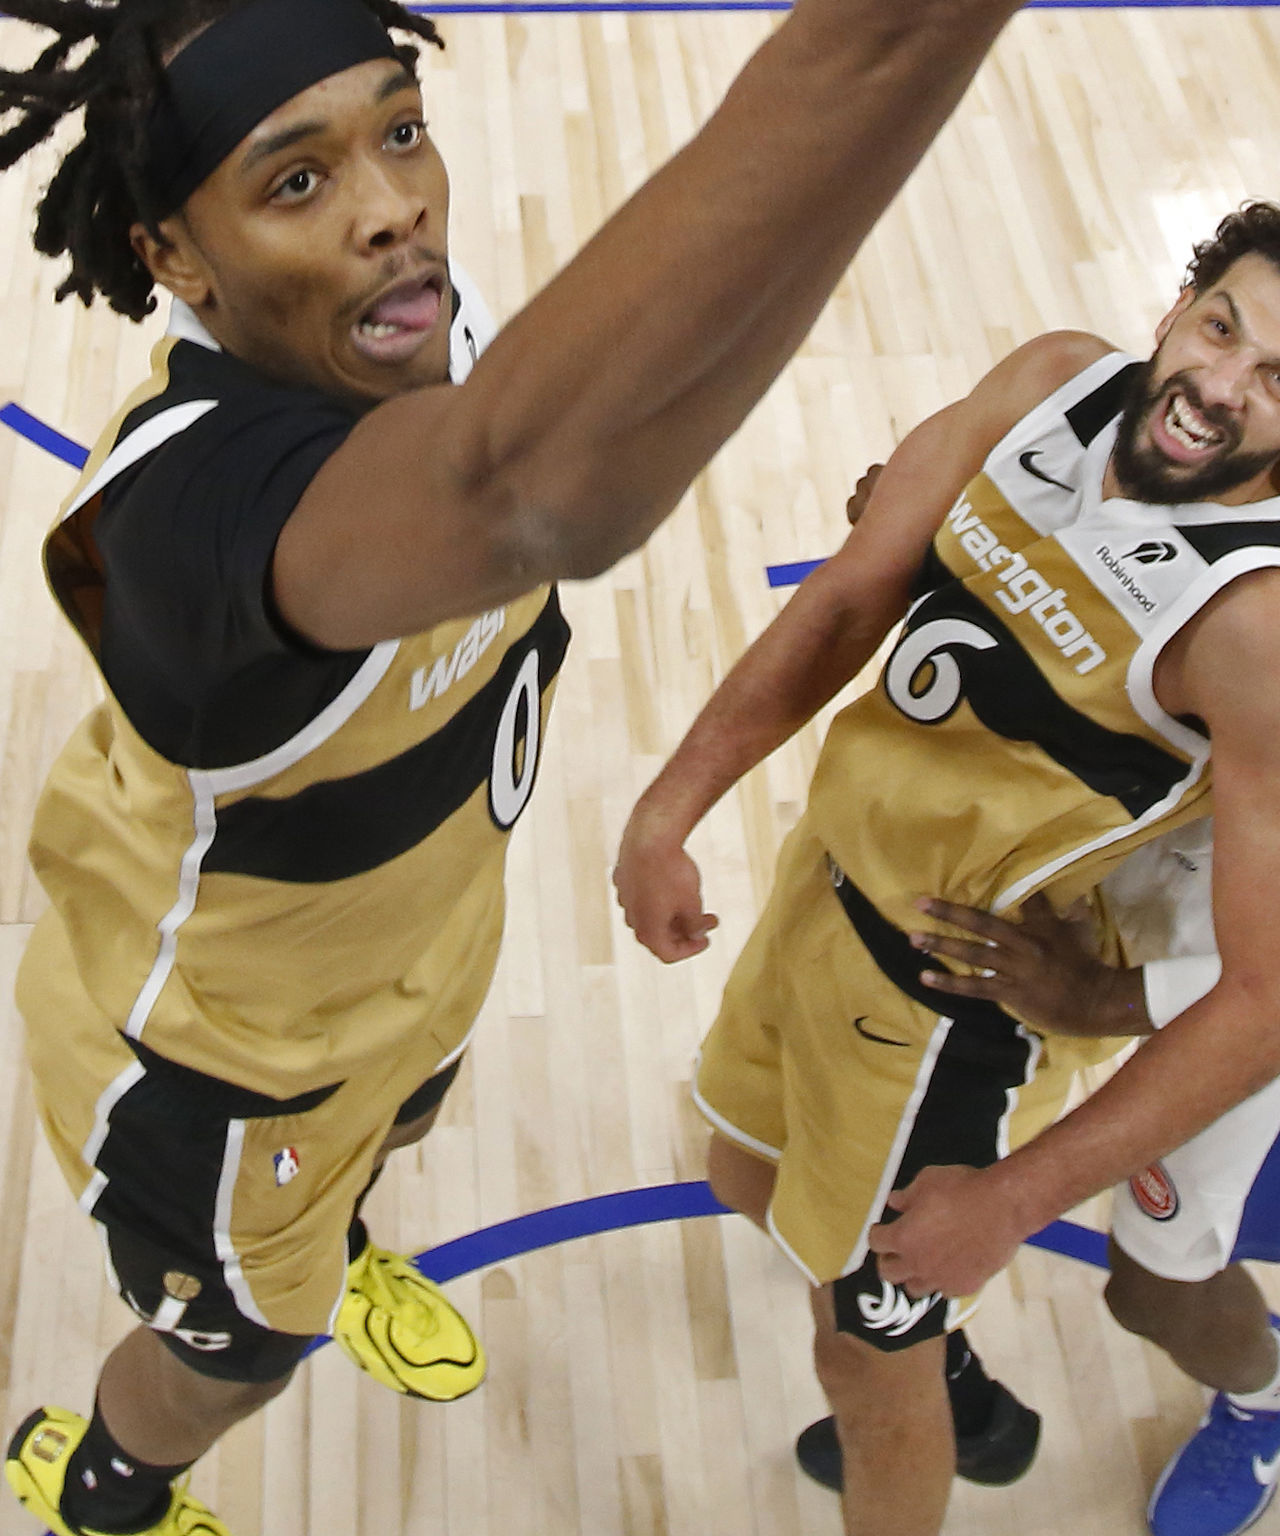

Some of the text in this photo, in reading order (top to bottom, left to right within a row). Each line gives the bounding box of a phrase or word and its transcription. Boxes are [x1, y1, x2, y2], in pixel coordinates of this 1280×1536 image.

[1095, 545, 1157, 613] Robinhood
[884, 617, 1000, 725] 6
[489, 648, 541, 831] 0
